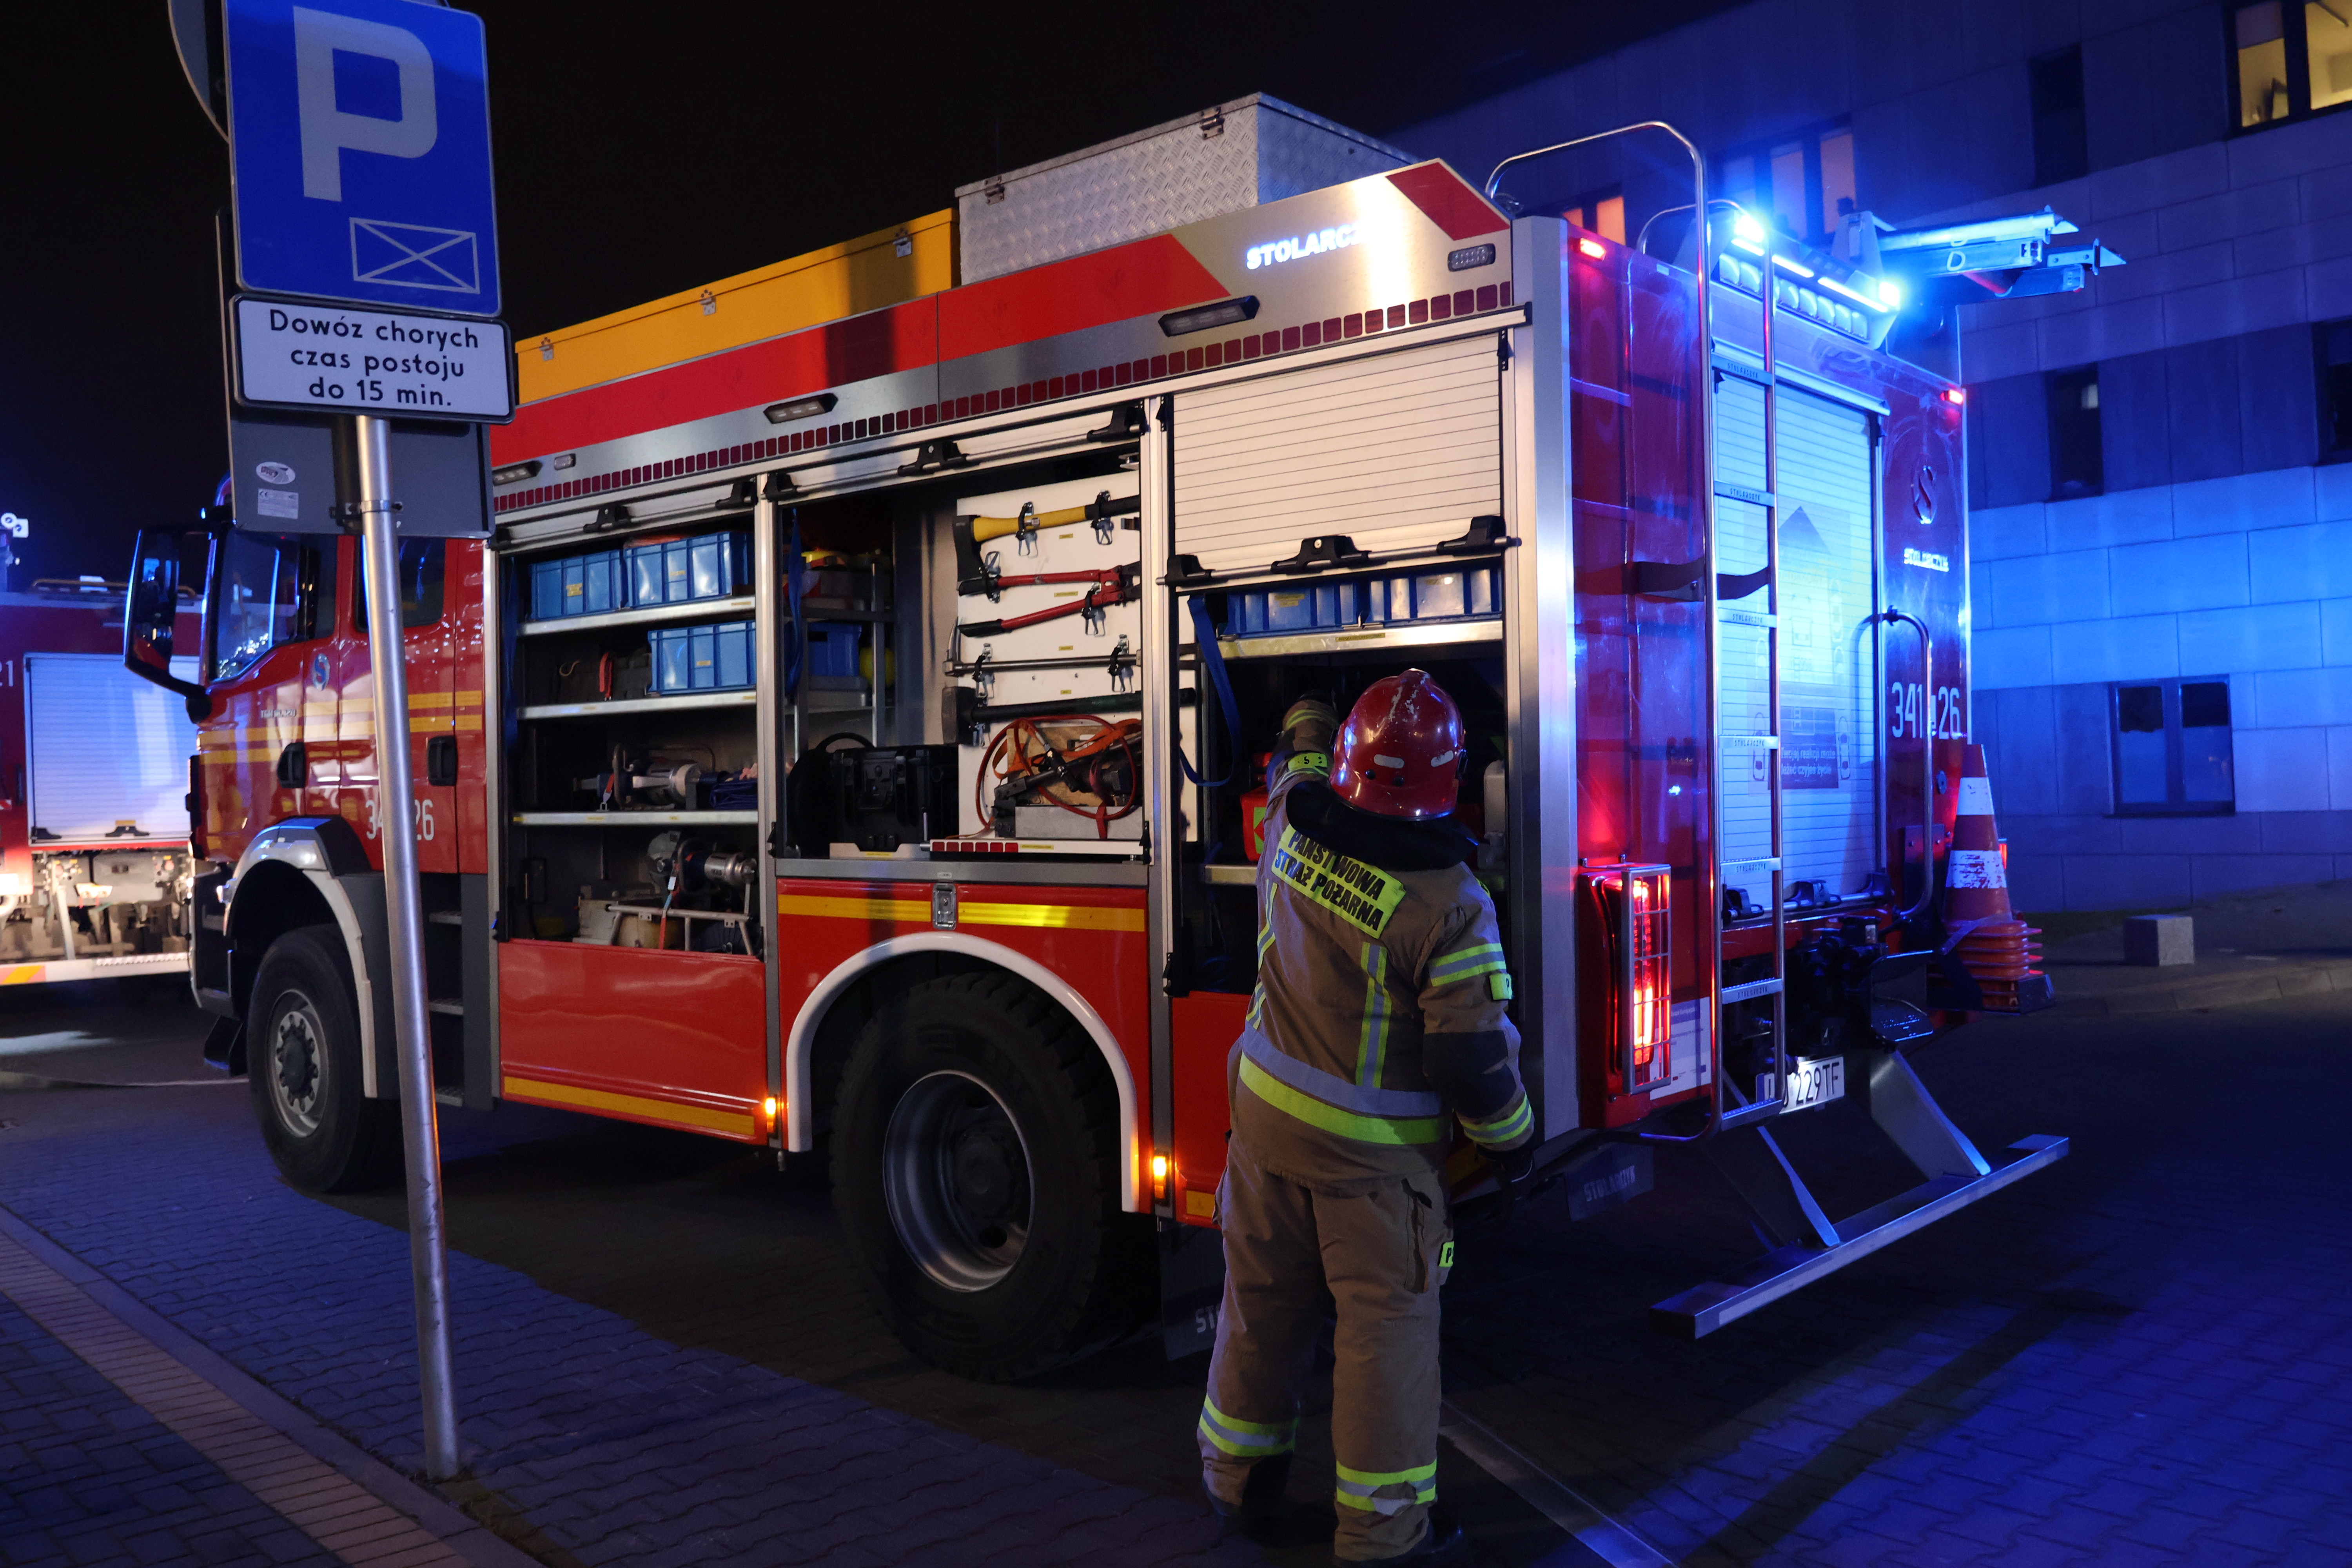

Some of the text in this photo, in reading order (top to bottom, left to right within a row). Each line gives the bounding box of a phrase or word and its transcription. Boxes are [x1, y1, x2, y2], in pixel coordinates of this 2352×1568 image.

[293, 6, 437, 202] P
[270, 309, 478, 352] Dowóz chorych
[291, 347, 464, 381] czas postoju
[310, 378, 453, 407] do 15 min.
[1310, 873, 1383, 931] POŻARNA
[1790, 1062, 1840, 1104] 229TF
